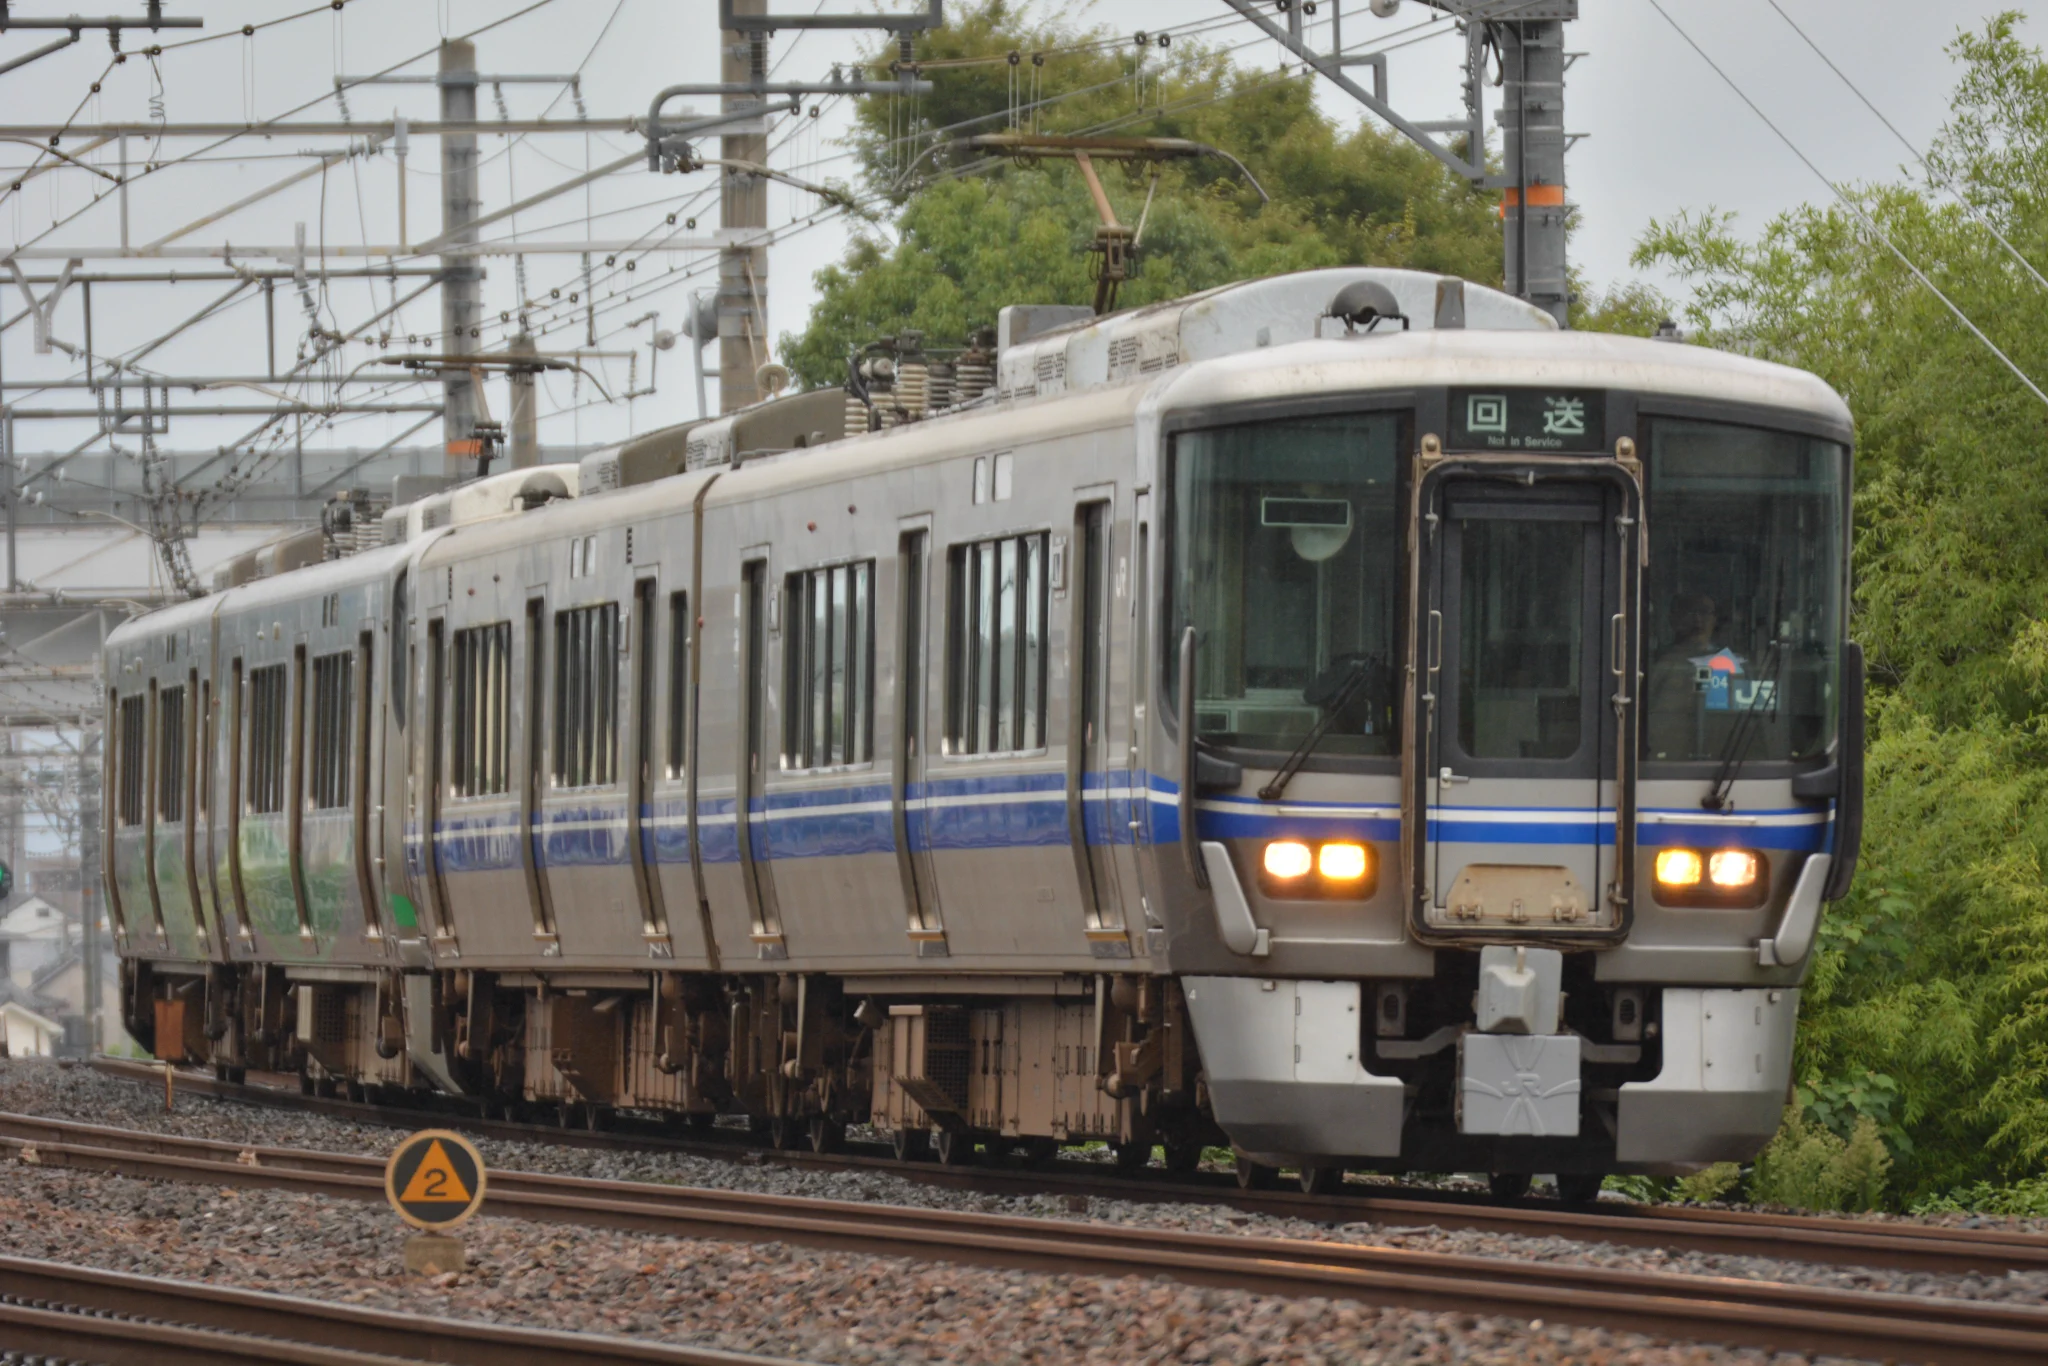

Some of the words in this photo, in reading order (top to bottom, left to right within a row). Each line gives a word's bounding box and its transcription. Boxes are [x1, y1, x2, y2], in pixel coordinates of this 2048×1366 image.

[1467, 395, 1585, 434] 回送
[1487, 435, 1506, 447] Not
[1525, 435, 1563, 448] Service
[1711, 676, 1729, 689] 04
[1735, 680, 1776, 705] JR
[424, 1167, 448, 1198] 2
